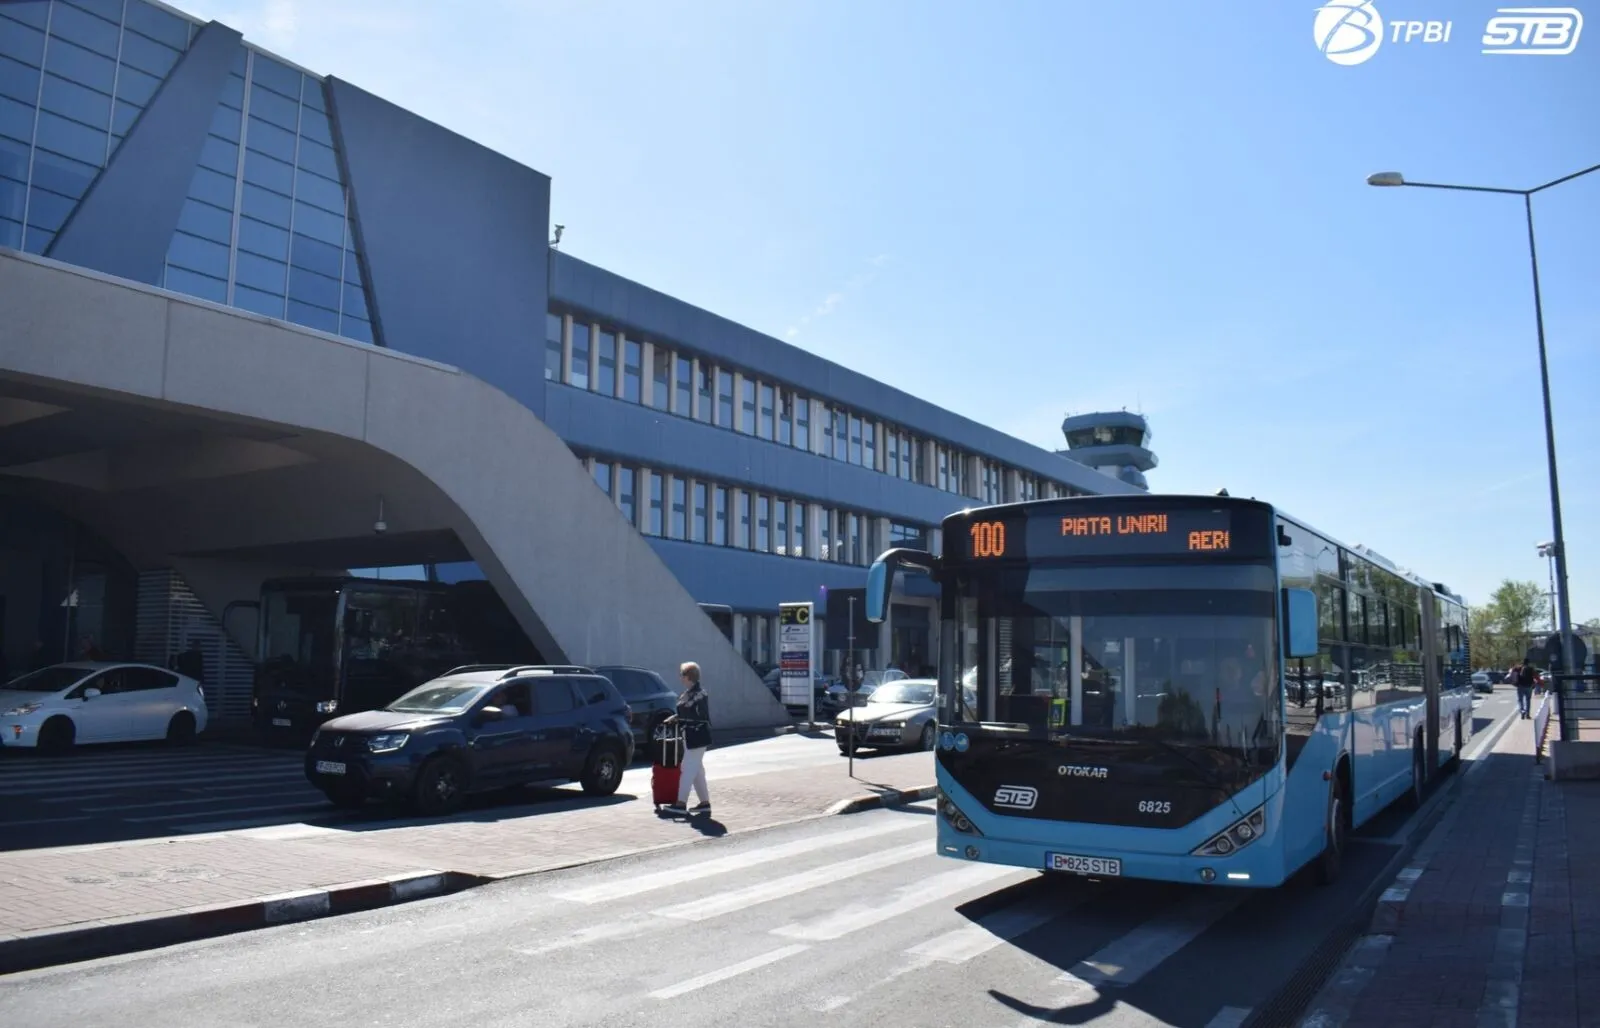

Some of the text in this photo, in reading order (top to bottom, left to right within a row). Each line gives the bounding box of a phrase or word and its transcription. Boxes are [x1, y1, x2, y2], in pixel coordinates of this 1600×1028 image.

[1062, 514, 1168, 536] PIATA UNIRII
[970, 522, 1005, 557] 100
[797, 608, 809, 624] C
[1058, 765, 1108, 778] OTOKAR
[995, 787, 1035, 806] STB
[1138, 801, 1171, 814] 6825
[1091, 859, 1118, 874] STB
